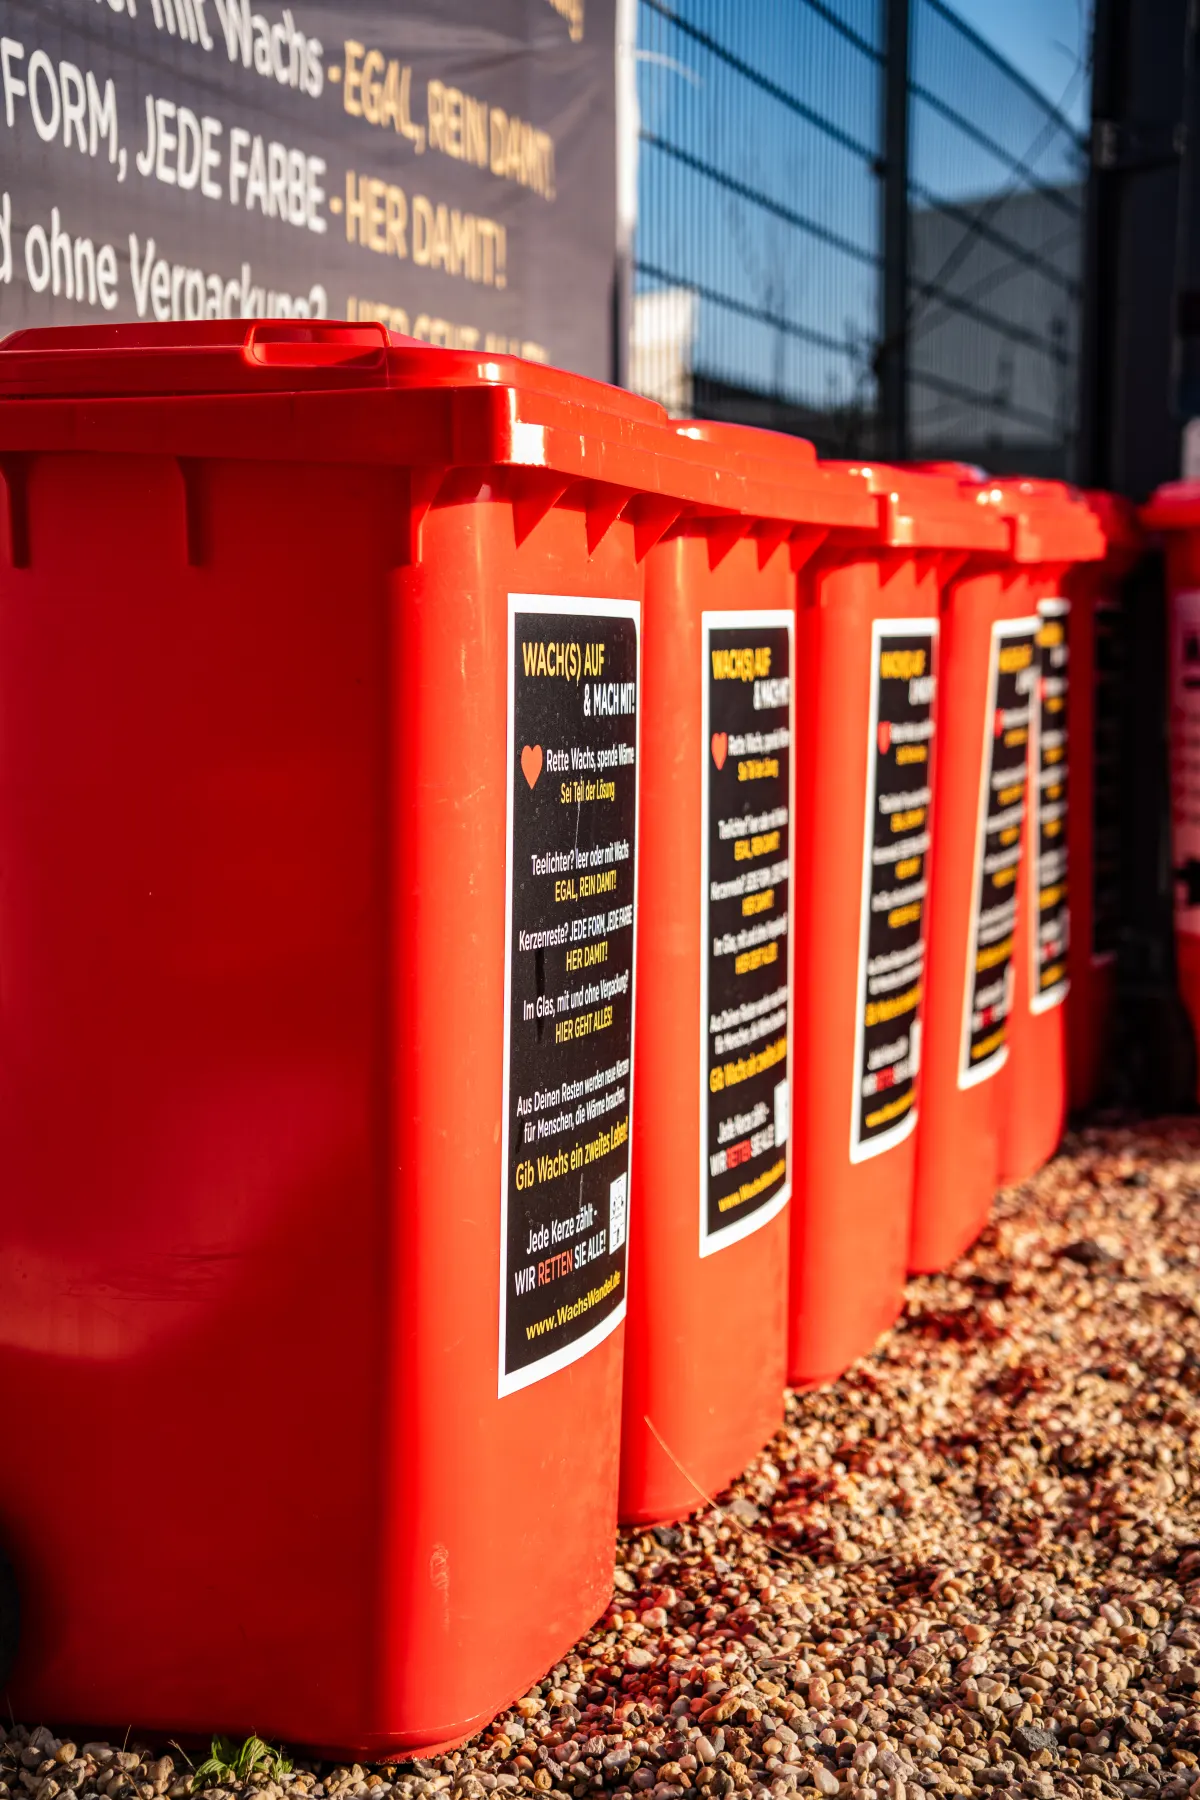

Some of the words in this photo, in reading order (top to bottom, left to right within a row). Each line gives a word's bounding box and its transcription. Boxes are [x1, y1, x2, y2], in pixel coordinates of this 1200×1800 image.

[214, 0, 324, 98] Wachs
[344, 39, 425, 155] EGAL,
[427, 79, 489, 169] REIN
[0, 36, 128, 182] FORM,
[136, 94, 222, 199] JEDE
[229, 127, 327, 234] FARBE
[346, 169, 407, 259] HER
[412, 195, 507, 290] DAMIT!
[25, 206, 118, 310] ohne
[128, 233, 328, 321] Verpacku
[522, 642, 582, 681] WACH(S)
[584, 643, 605, 676] AUF
[583, 683, 591, 716] &
[593, 683, 620, 715] MACH
[620, 682, 636, 714] MIT!
[546, 749, 569, 772] Rette
[570, 746, 597, 773] Wachs,
[597, 744, 618, 772] spende
[561, 783, 573, 804] Sei
[574, 779, 585, 803] Teil
[585, 779, 596, 801] der
[596, 779, 615, 802] Lösung
[531, 850, 575, 875] Teelichter?
[576, 848, 589, 869] leer
[590, 846, 604, 866] oder
[555, 878, 578, 902] EGAL,
[579, 875, 596, 898] REIN
[596, 870, 617, 895] DAMIT!
[519, 922, 569, 951] Kerzenreste?
[569, 916, 587, 941] JEDE
[588, 912, 606, 938] FORM,
[606, 908, 619, 932] JEDE
[566, 949, 583, 972] HER
[584, 941, 608, 968] DAMIT!
[523, 999, 534, 1021] Im
[536, 994, 556, 1018] Glas,
[557, 990, 570, 1013] mit
[571, 985, 583, 1010] und
[584, 981, 600, 1004] ohne
[555, 1020, 573, 1044] HIER
[574, 1013, 592, 1038] GEHT
[593, 1005, 613, 1032] ALLES!
[517, 1095, 532, 1117] Aus
[534, 1088, 560, 1112] Deinen
[561, 1080, 584, 1103] Resten
[584, 1069, 605, 1093] werden
[524, 1121, 536, 1143] für
[538, 1111, 574, 1139] Menschen,
[575, 1104, 586, 1126] die
[586, 1098, 605, 1121] Wärme
[516, 1159, 534, 1190] Gib
[537, 1148, 569, 1183] Wachs
[570, 1143, 583, 1171] ein
[584, 1131, 610, 1165] zweites
[526, 1224, 549, 1255] Jede
[551, 1216, 574, 1245] Kerze
[575, 1203, 593, 1233] zählt
[515, 1265, 536, 1296] WIR
[538, 1249, 573, 1287] RETTEN
[574, 1241, 586, 1270] SIE
[587, 1229, 606, 1263] ALLE!
[526, 1270, 621, 1340] www.WachsWandel.de
